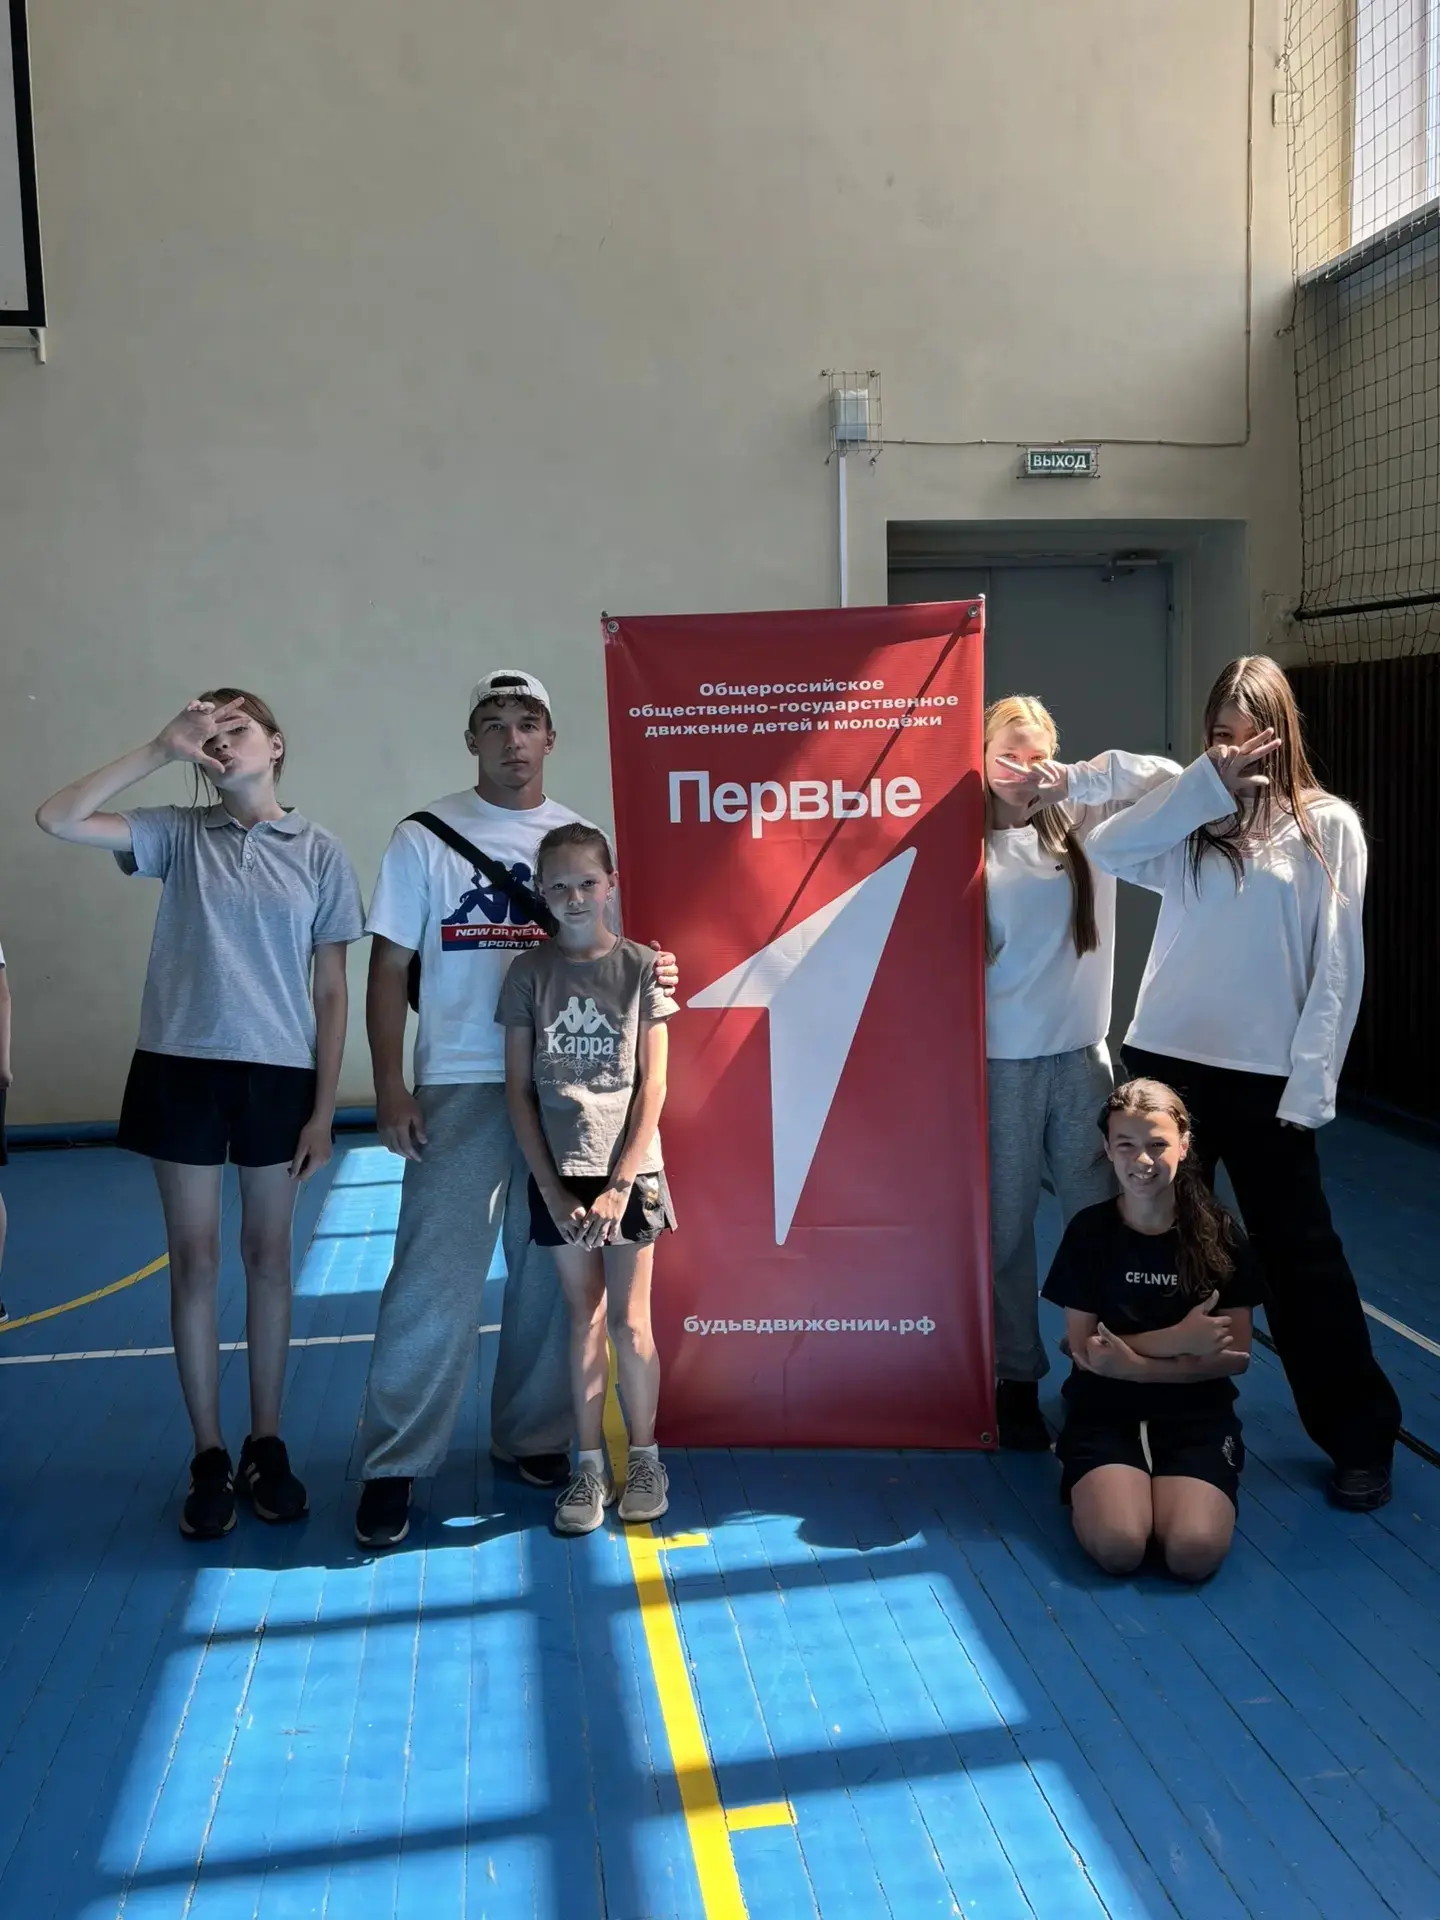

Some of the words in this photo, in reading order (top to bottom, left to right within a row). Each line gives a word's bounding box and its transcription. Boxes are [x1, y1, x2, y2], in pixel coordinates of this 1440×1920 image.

[1033, 454, 1086, 468] ВЫХОД
[699, 678, 884, 697] Общероссийское
[628, 693, 959, 718] общественно-государственное
[644, 723, 748, 738] движение
[752, 717, 812, 735] детей
[817, 719, 829, 731] и
[834, 713, 943, 732] молодёжи
[668, 770, 922, 839] Первые
[455, 927, 489, 937] NOW
[492, 927, 508, 936] OR
[511, 927, 547, 937] NEVE
[478, 940, 540, 948] SPORTIVA
[547, 1032, 615, 1060] Kappa
[683, 1315, 937, 1336] будьвдвижении.рф
